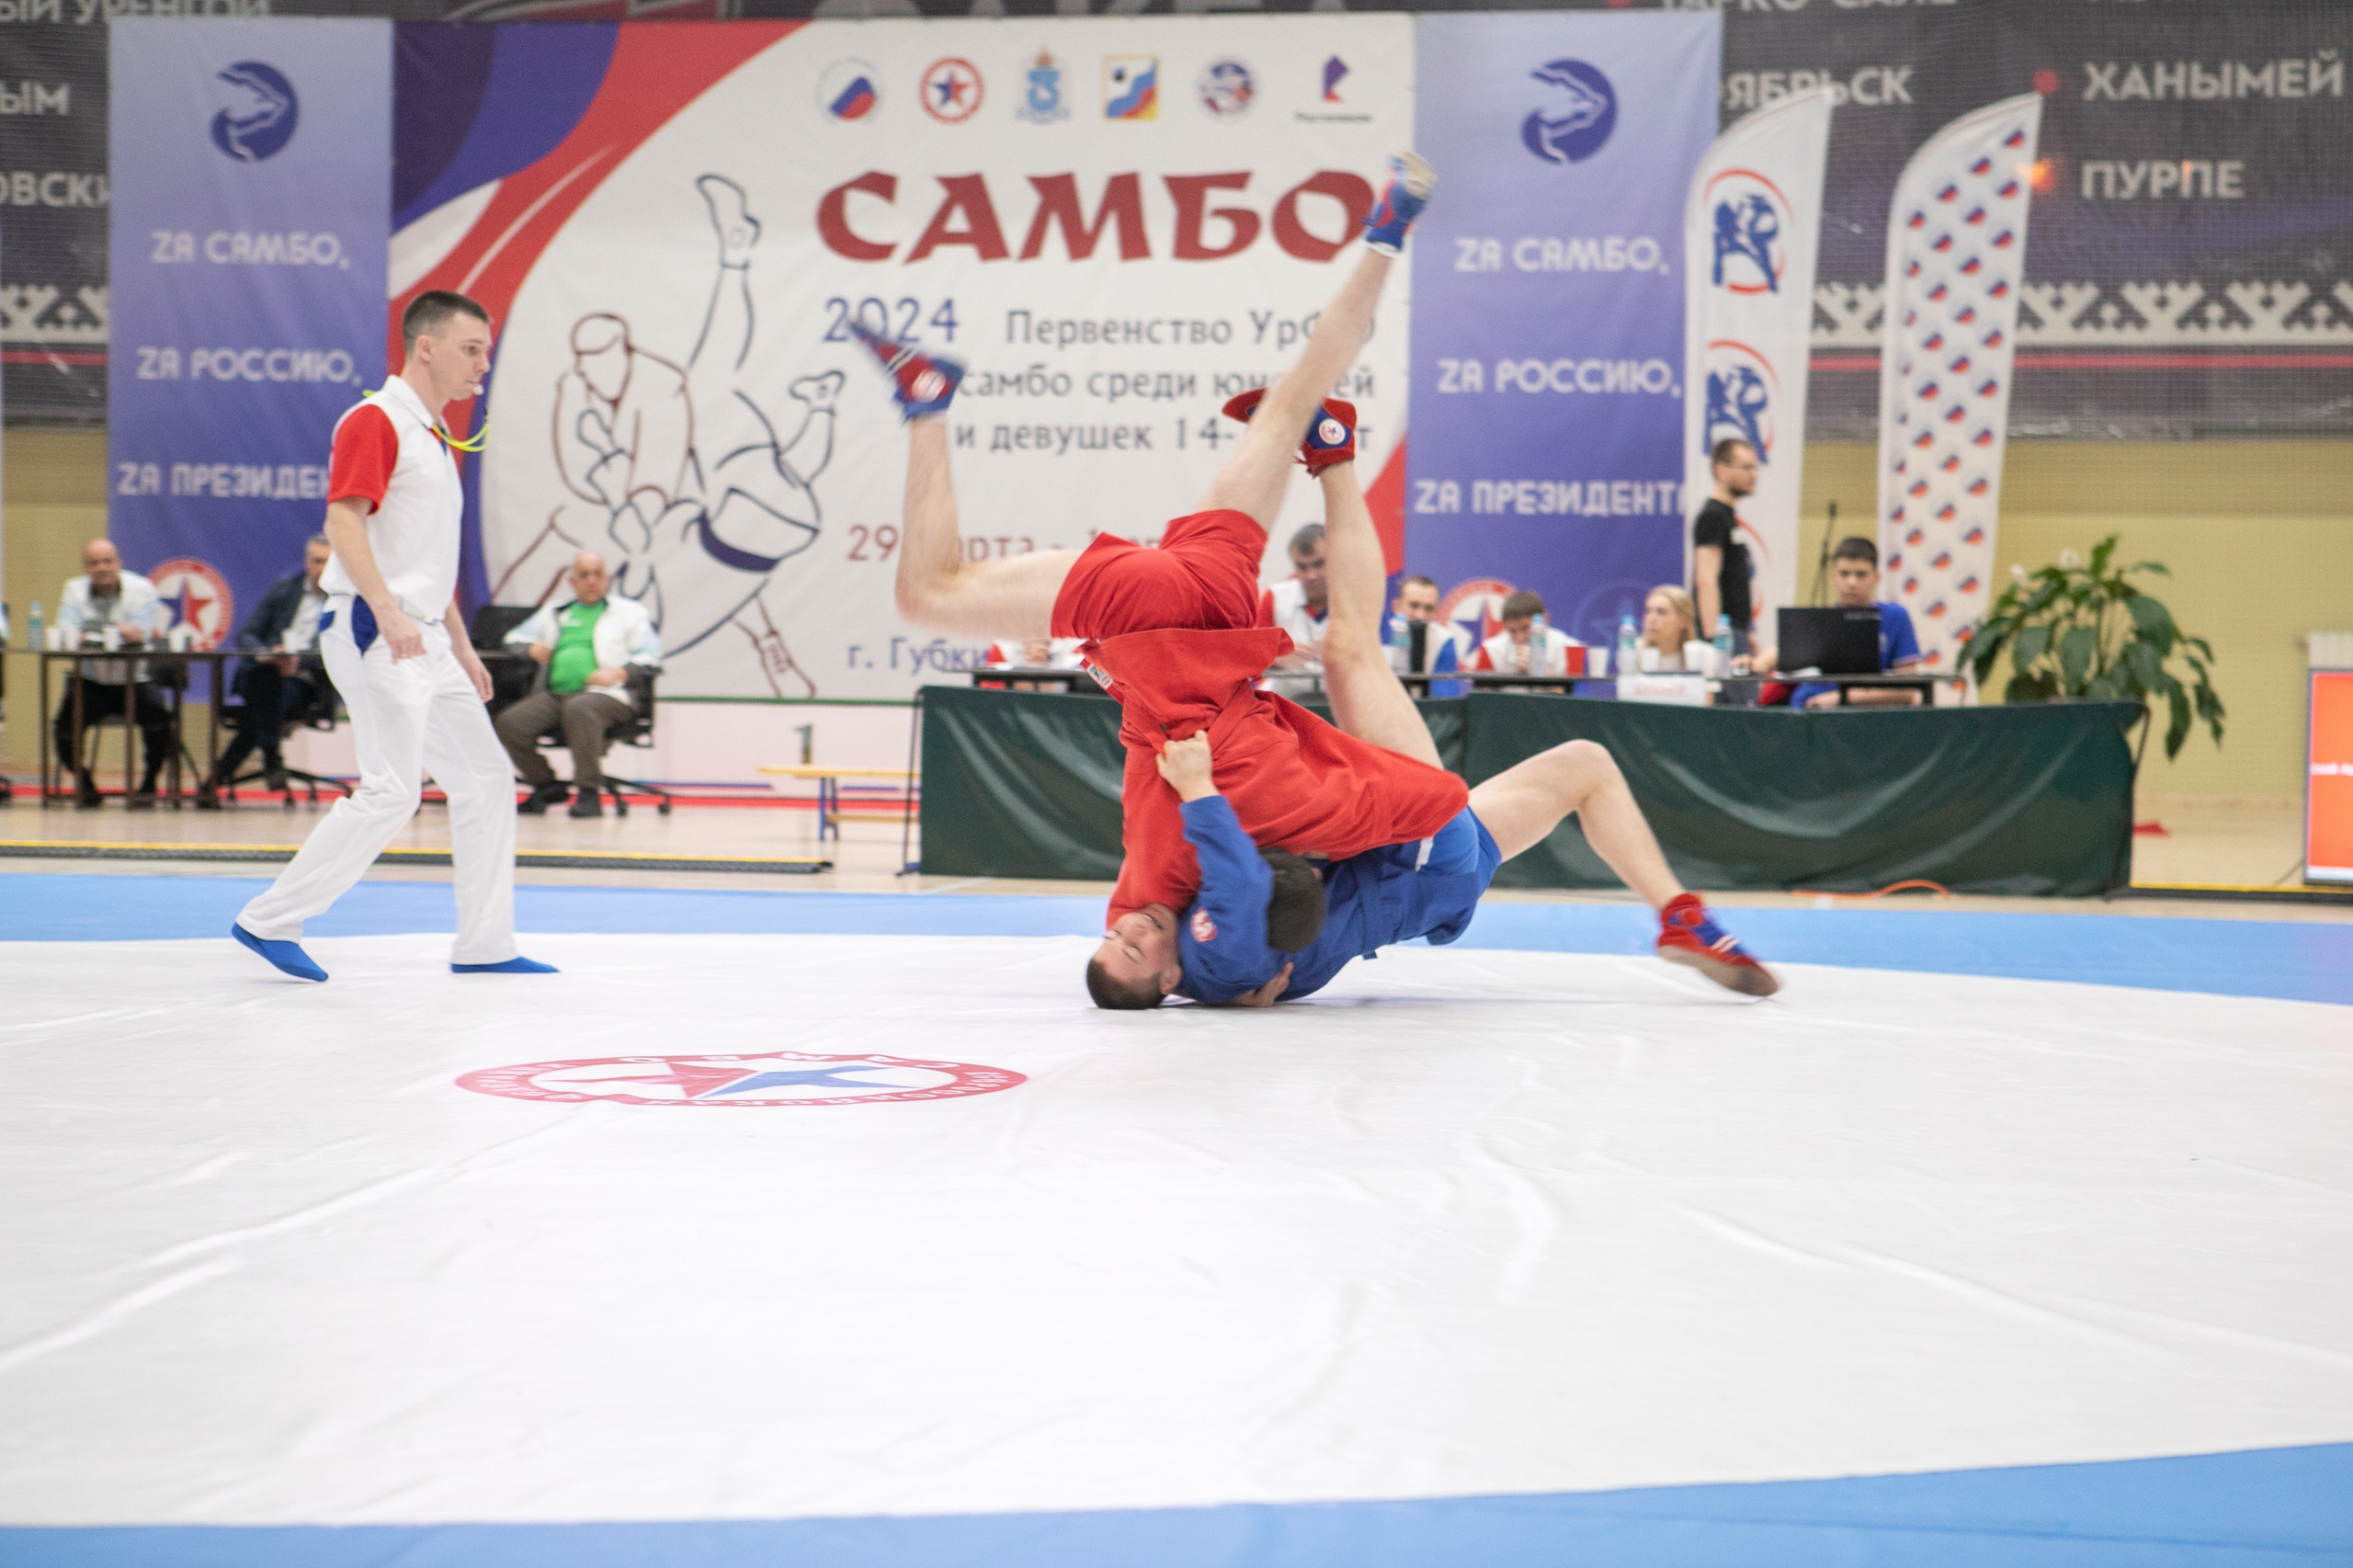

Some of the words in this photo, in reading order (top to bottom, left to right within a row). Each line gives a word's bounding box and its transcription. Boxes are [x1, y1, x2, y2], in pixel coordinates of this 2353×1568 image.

[2084, 49, 2344, 100] ХАНЫМЕЙ
[0, 171, 109, 207] ВСК
[2082, 160, 2245, 199] ПУРПЕ
[817, 171, 1375, 264] САМБО
[822, 297, 959, 343] 2024
[1006, 309, 1233, 351] Первенство
[1249, 308, 1376, 351] Ур
[958, 364, 1074, 398] самбо
[1086, 370, 1197, 404] среди
[1212, 366, 1374, 397] юней
[956, 425, 975, 449] и
[990, 423, 1152, 454] девушек
[847, 524, 899, 562] 29
